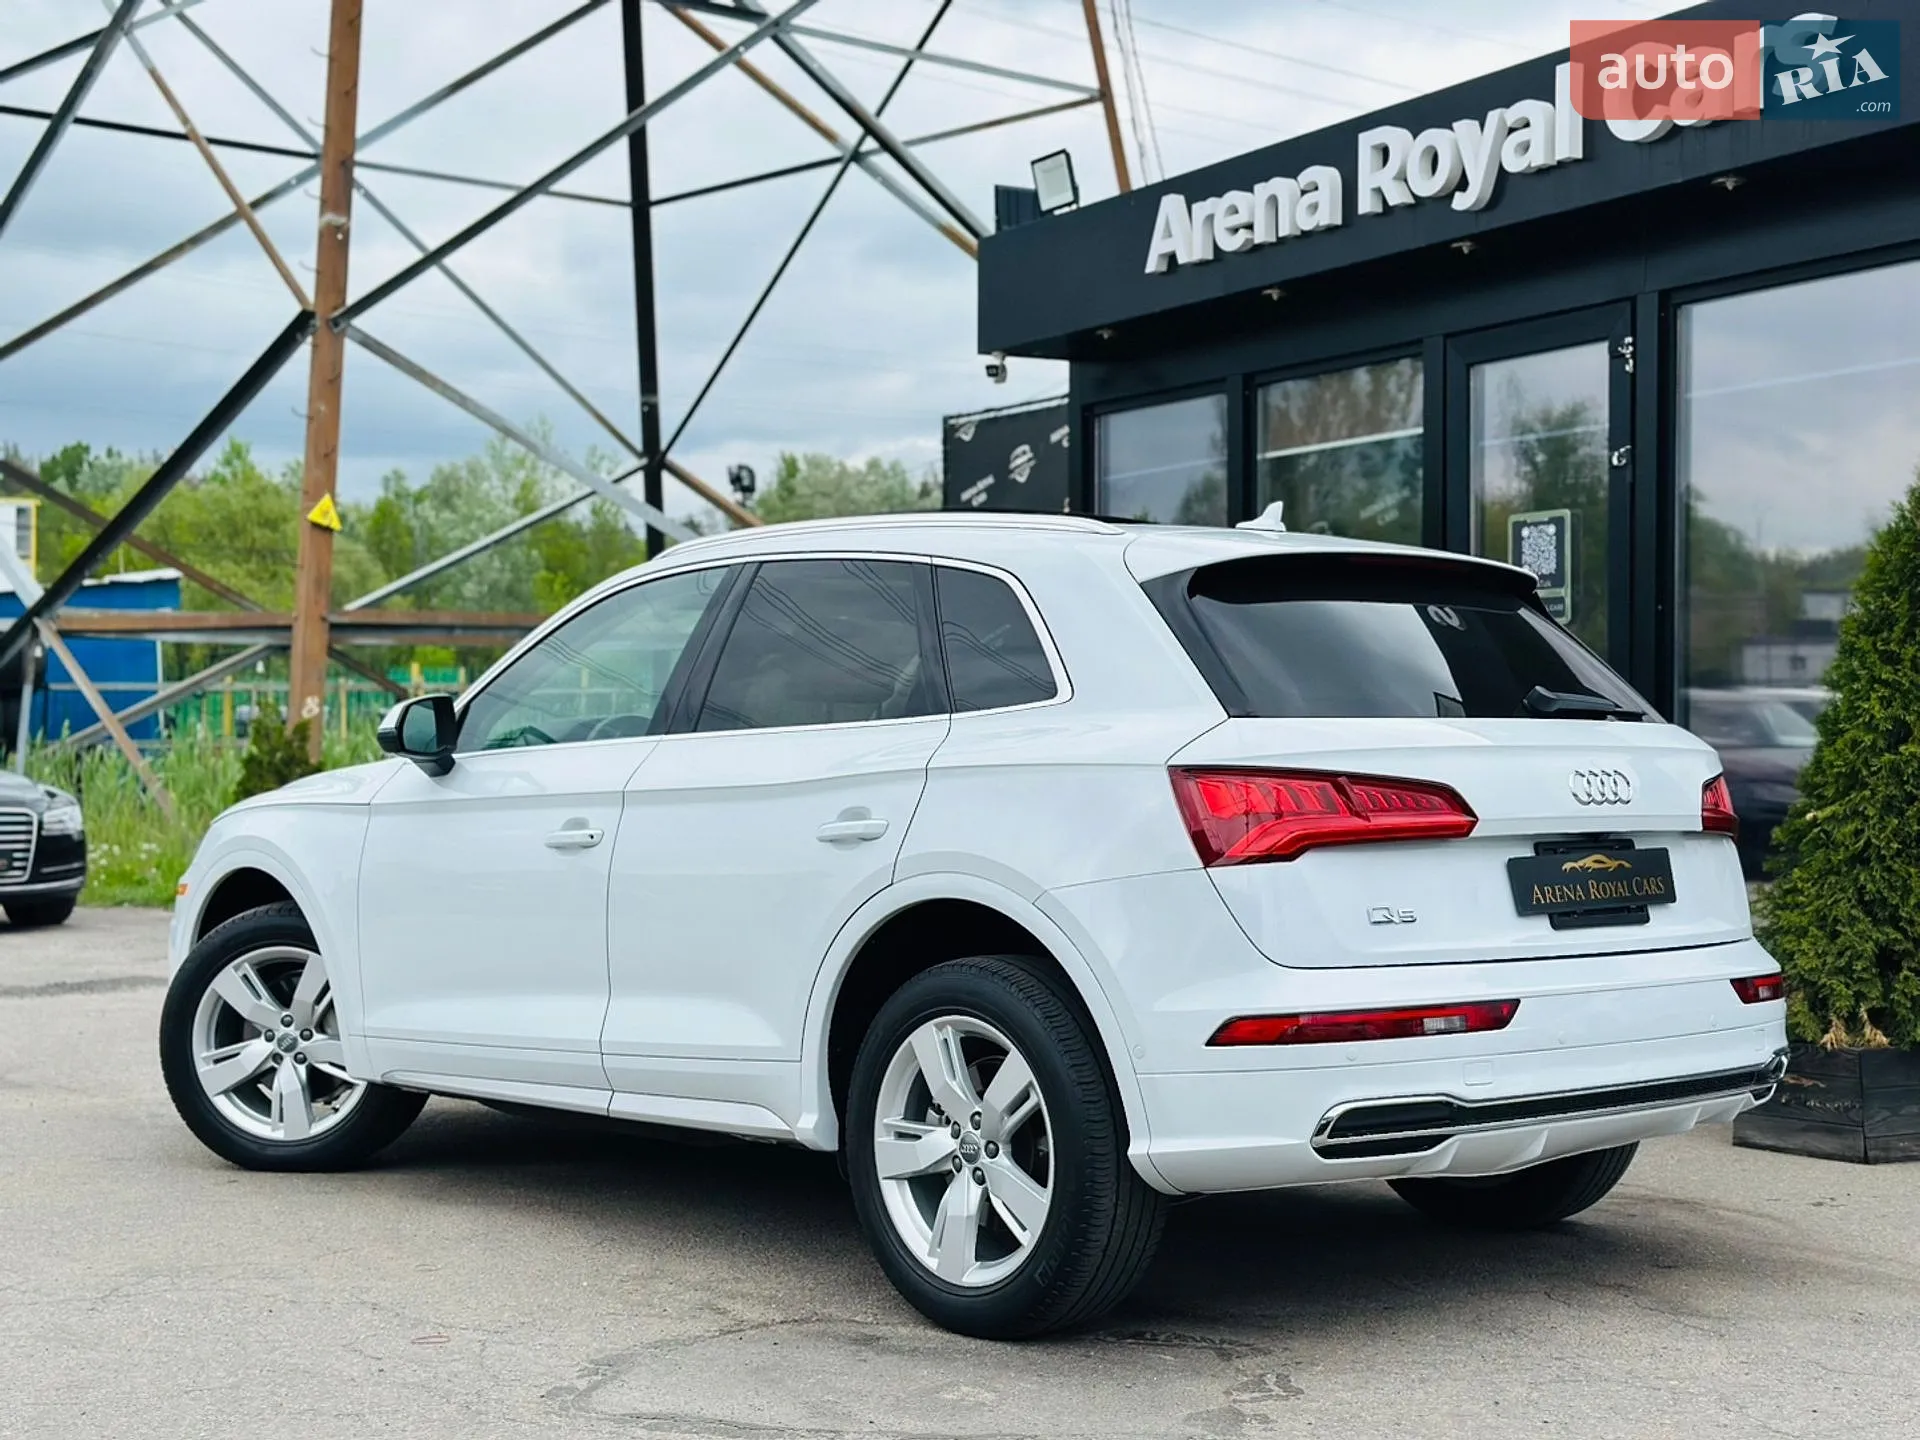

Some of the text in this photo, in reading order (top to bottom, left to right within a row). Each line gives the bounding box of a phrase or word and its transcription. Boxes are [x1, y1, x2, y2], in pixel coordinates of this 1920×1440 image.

[1144, 12, 1839, 274] Arena Royal Cars
[1532, 875, 1666, 905] ARENA ROYAL CARS
[1366, 905, 1418, 925] Q5
